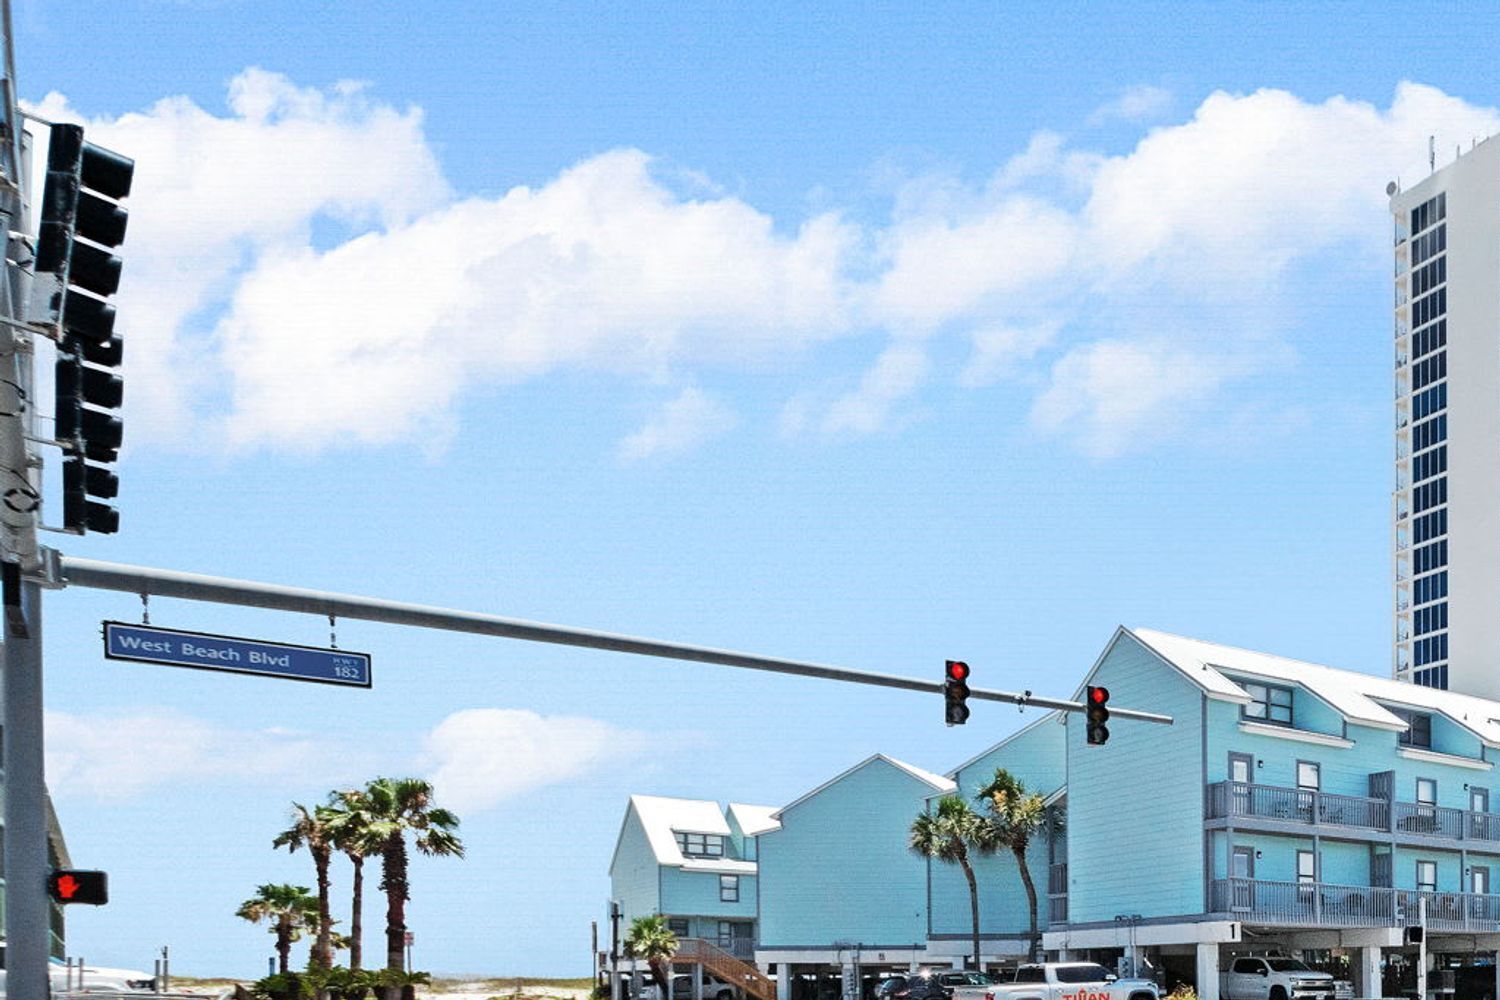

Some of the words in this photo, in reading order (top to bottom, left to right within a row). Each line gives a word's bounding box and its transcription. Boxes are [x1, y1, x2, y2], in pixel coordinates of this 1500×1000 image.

[117, 635, 172, 654] West
[181, 643, 240, 661] Beach
[249, 651, 290, 668] Blvd
[335, 666, 360, 680] 182
[1229, 923, 1235, 939] 1
